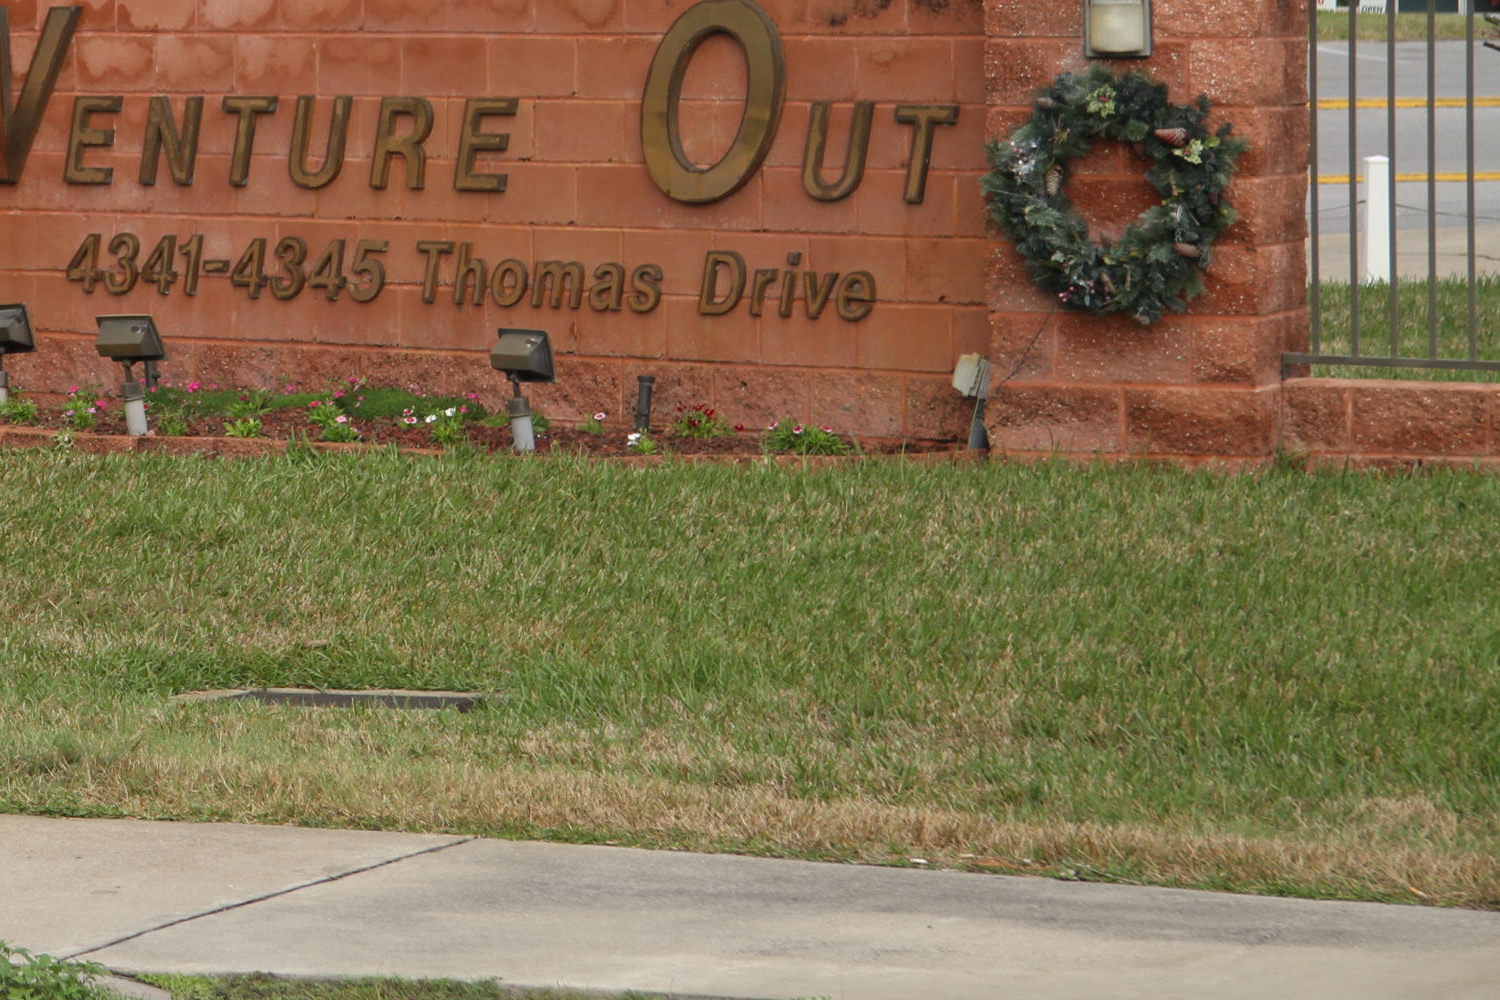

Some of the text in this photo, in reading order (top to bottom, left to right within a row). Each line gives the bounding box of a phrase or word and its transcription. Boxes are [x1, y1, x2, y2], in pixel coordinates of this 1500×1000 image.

[66, 232, 876, 322] 4341-4345 Thomas Drive
